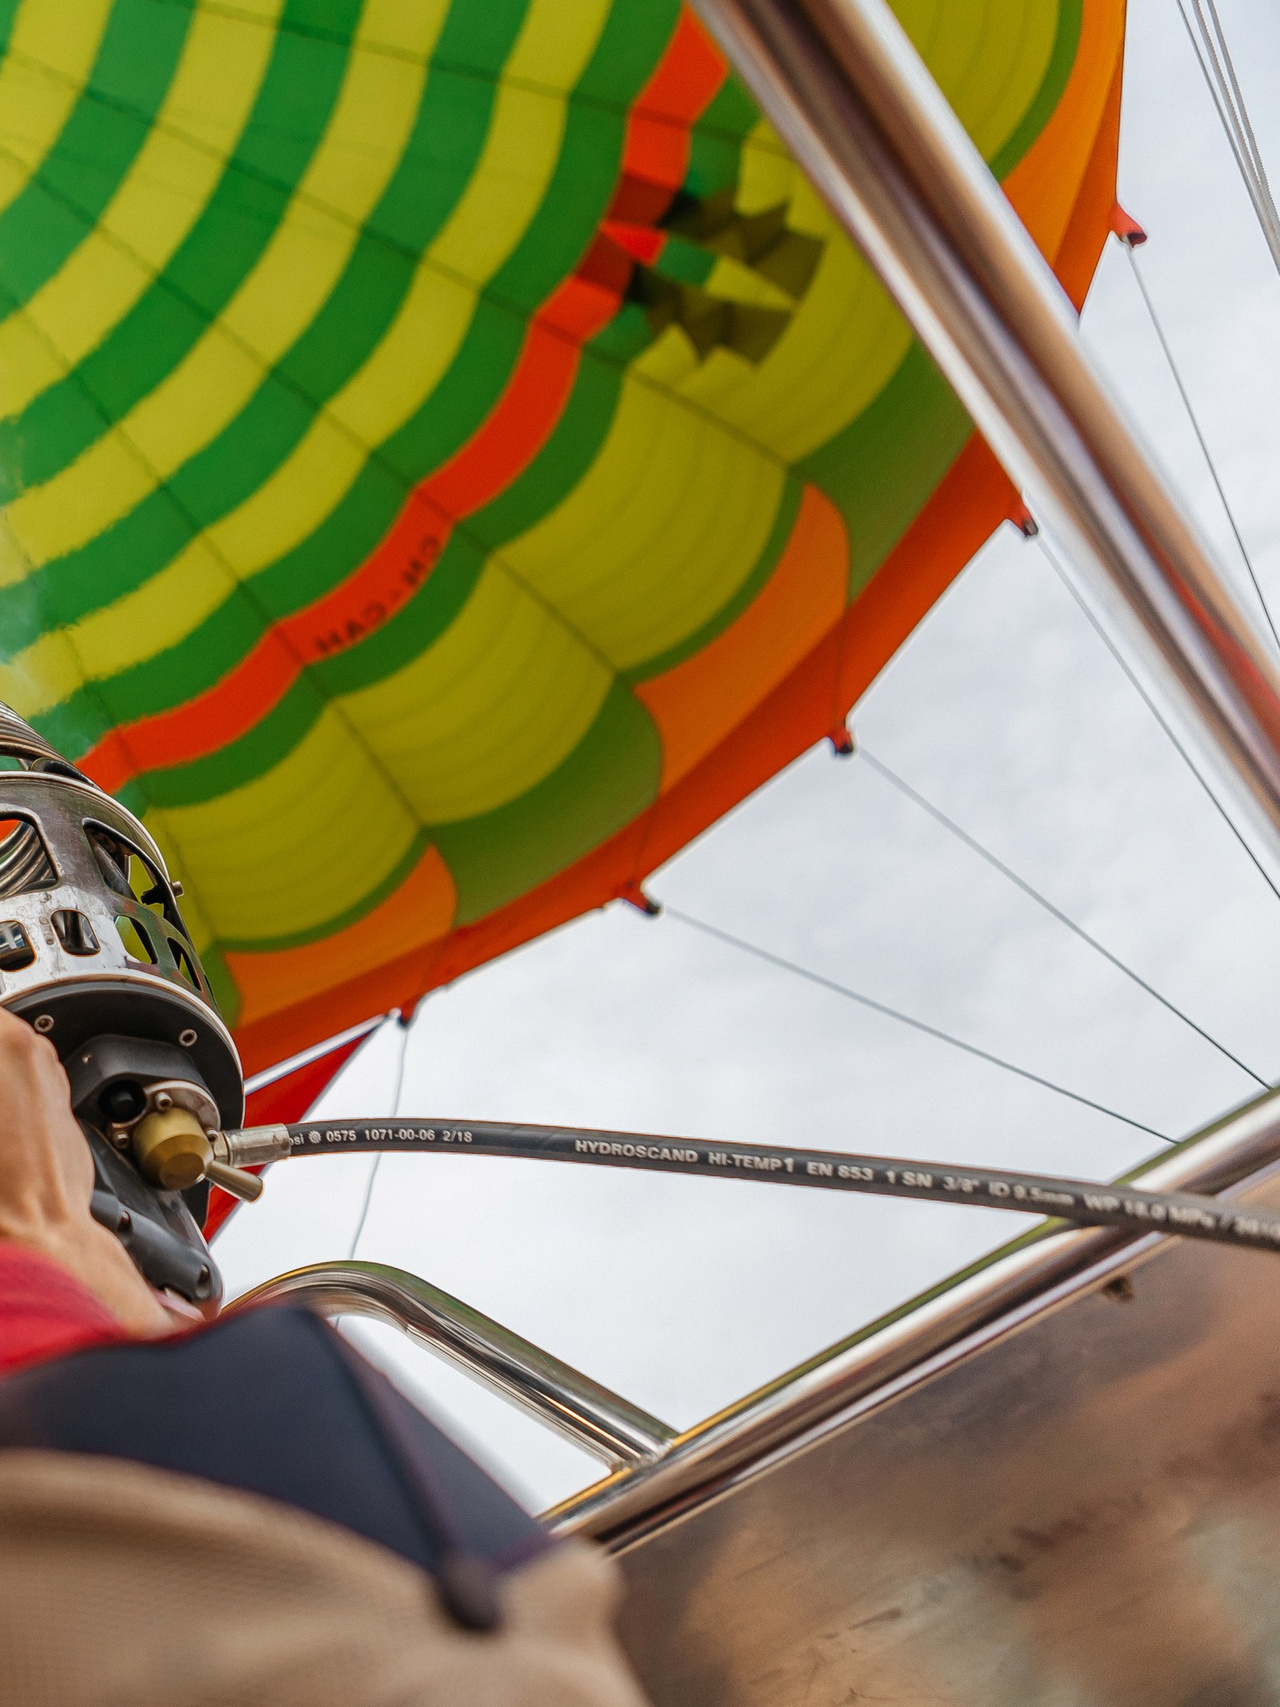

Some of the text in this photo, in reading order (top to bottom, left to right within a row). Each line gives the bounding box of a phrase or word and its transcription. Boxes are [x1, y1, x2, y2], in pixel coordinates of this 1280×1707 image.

[325, 1129, 357, 1143] 0575
[364, 1128, 436, 1142] 1071-00-06
[442, 1129, 473, 1143] 2/18
[575, 1139, 699, 1163] HYDROSCAND
[806, 1161, 834, 1178] EN
[837, 1164, 874, 1182] 853
[902, 1171, 934, 1188] SN
